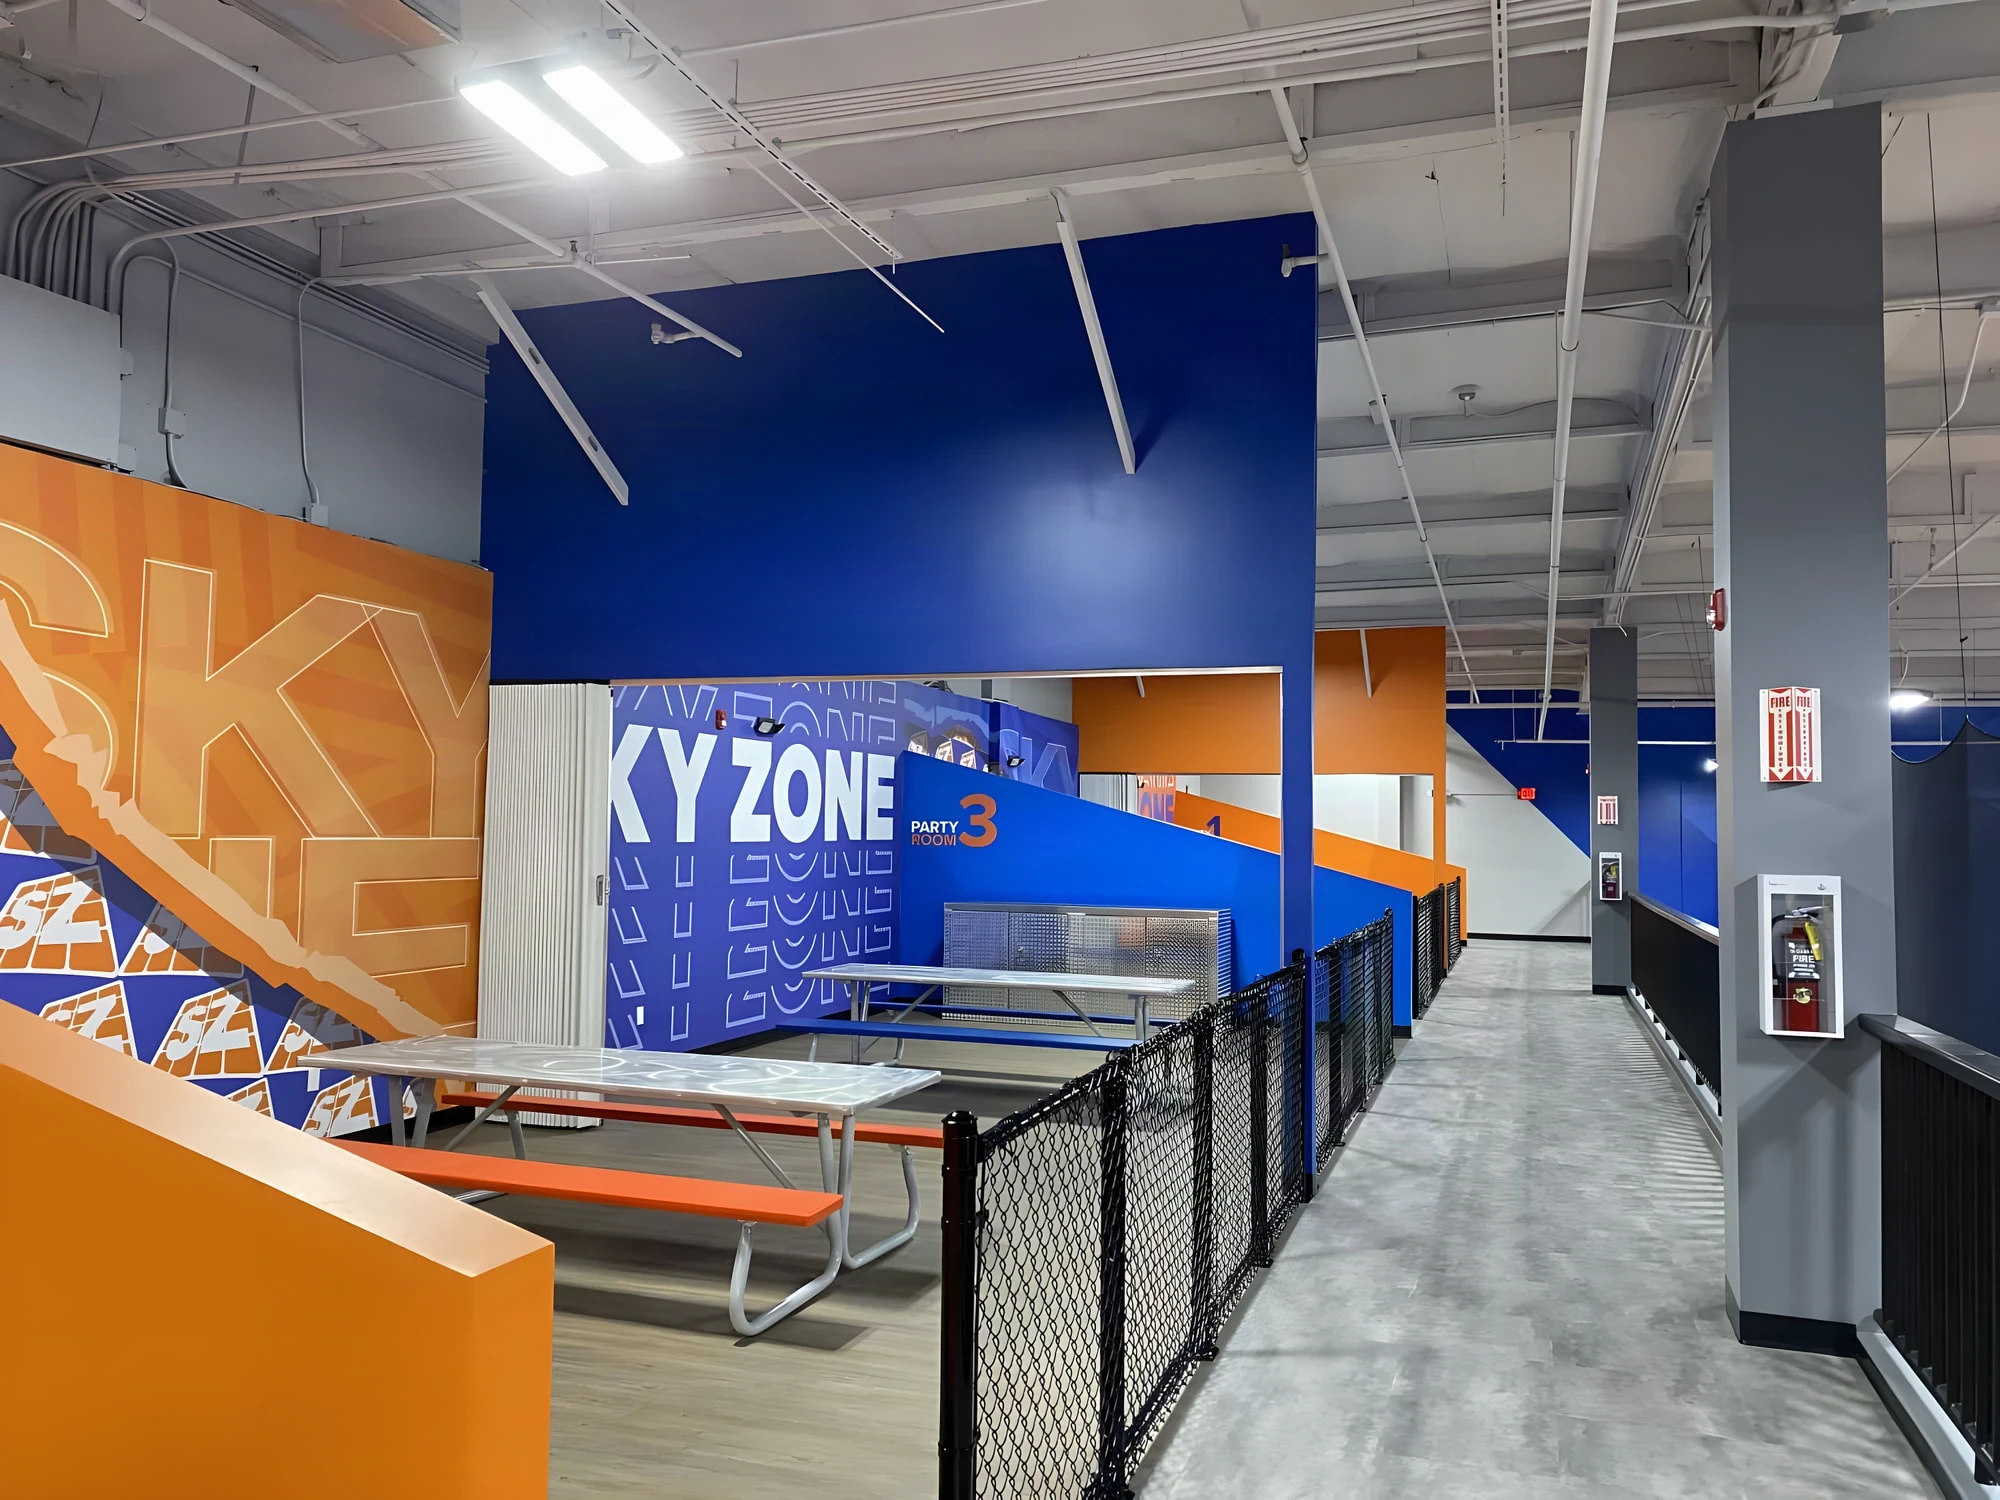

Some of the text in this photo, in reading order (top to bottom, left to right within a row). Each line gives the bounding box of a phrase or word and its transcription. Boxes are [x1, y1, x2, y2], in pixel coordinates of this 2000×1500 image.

[1770, 696, 1791, 708] FIRE
[730, 736, 896, 843] ZONE
[911, 821, 959, 833] PARTY
[911, 834, 956, 846] ROOM
[959, 793, 997, 847] 3
[0, 876, 102, 950] SZ
[166, 988, 250, 1061] SZ
[302, 1079, 370, 1138] SZ
